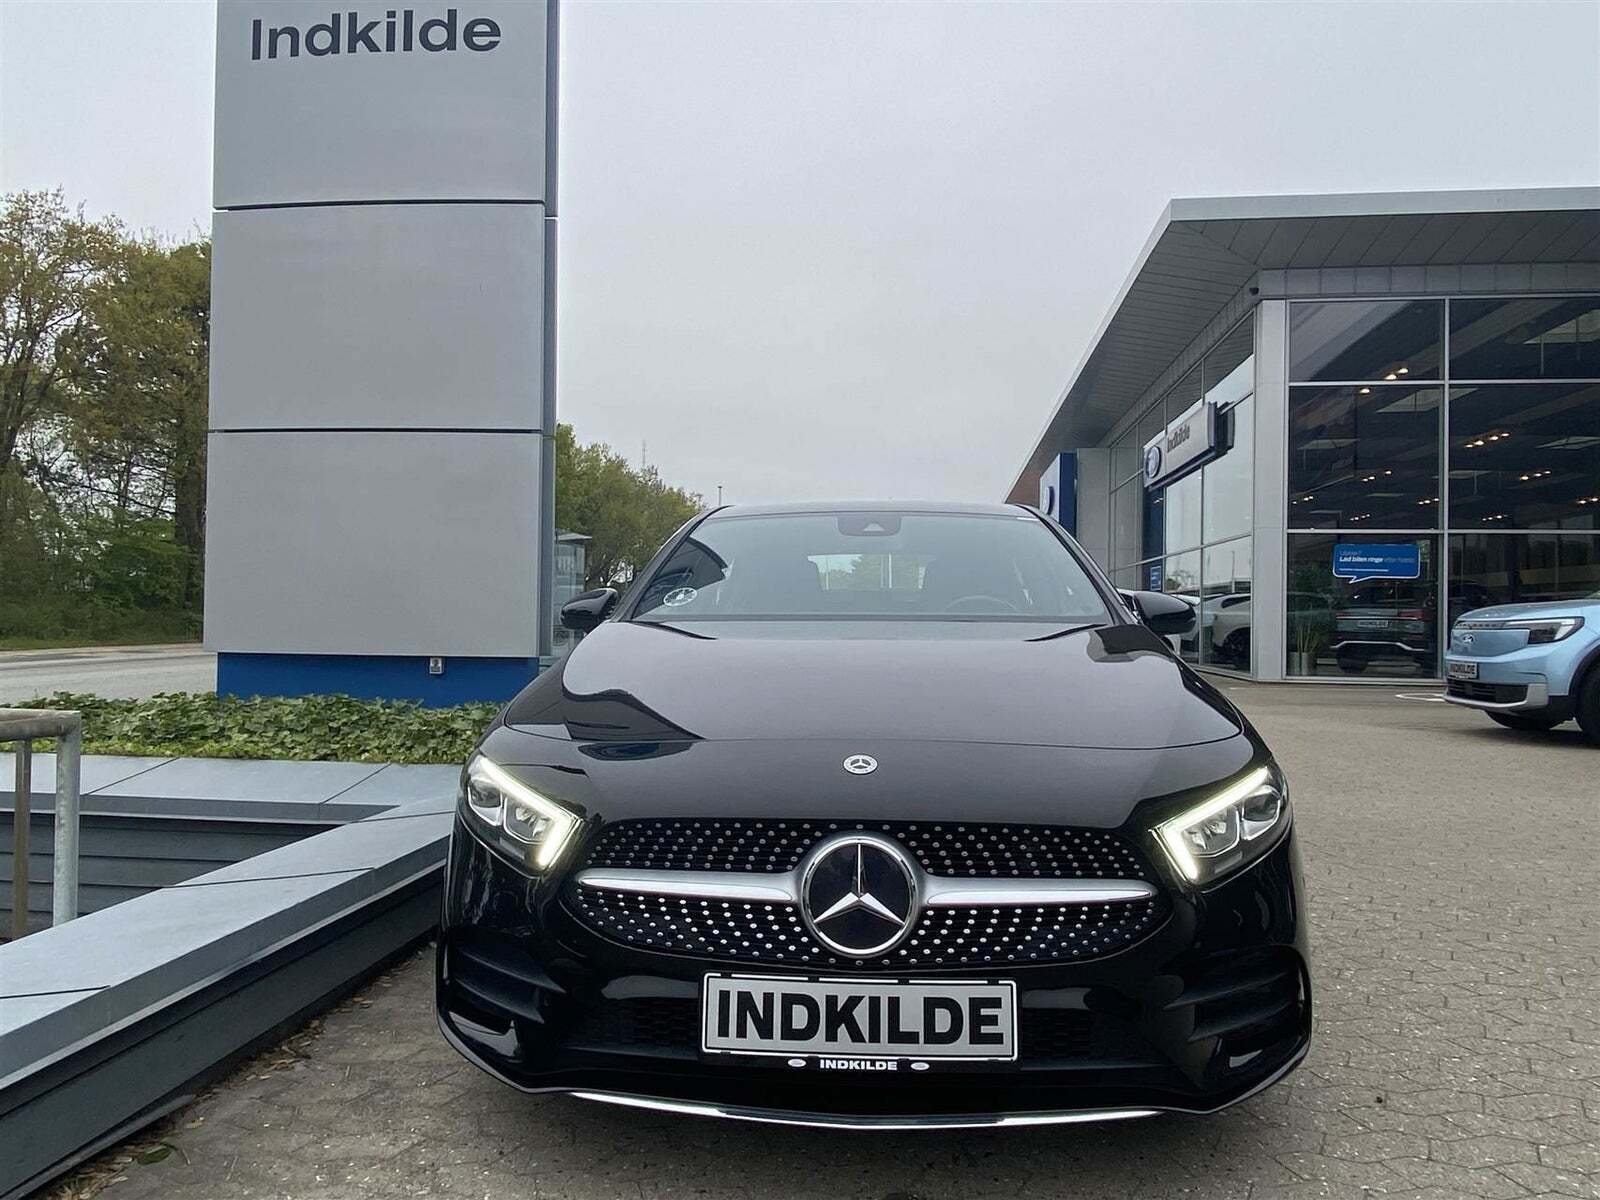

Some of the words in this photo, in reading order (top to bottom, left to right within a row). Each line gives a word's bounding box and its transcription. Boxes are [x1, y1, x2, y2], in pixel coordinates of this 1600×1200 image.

[251, 9, 501, 60] Indkilde
[717, 990, 1004, 1045] INDKILDE
[820, 1059, 898, 1071] INDKILDE
